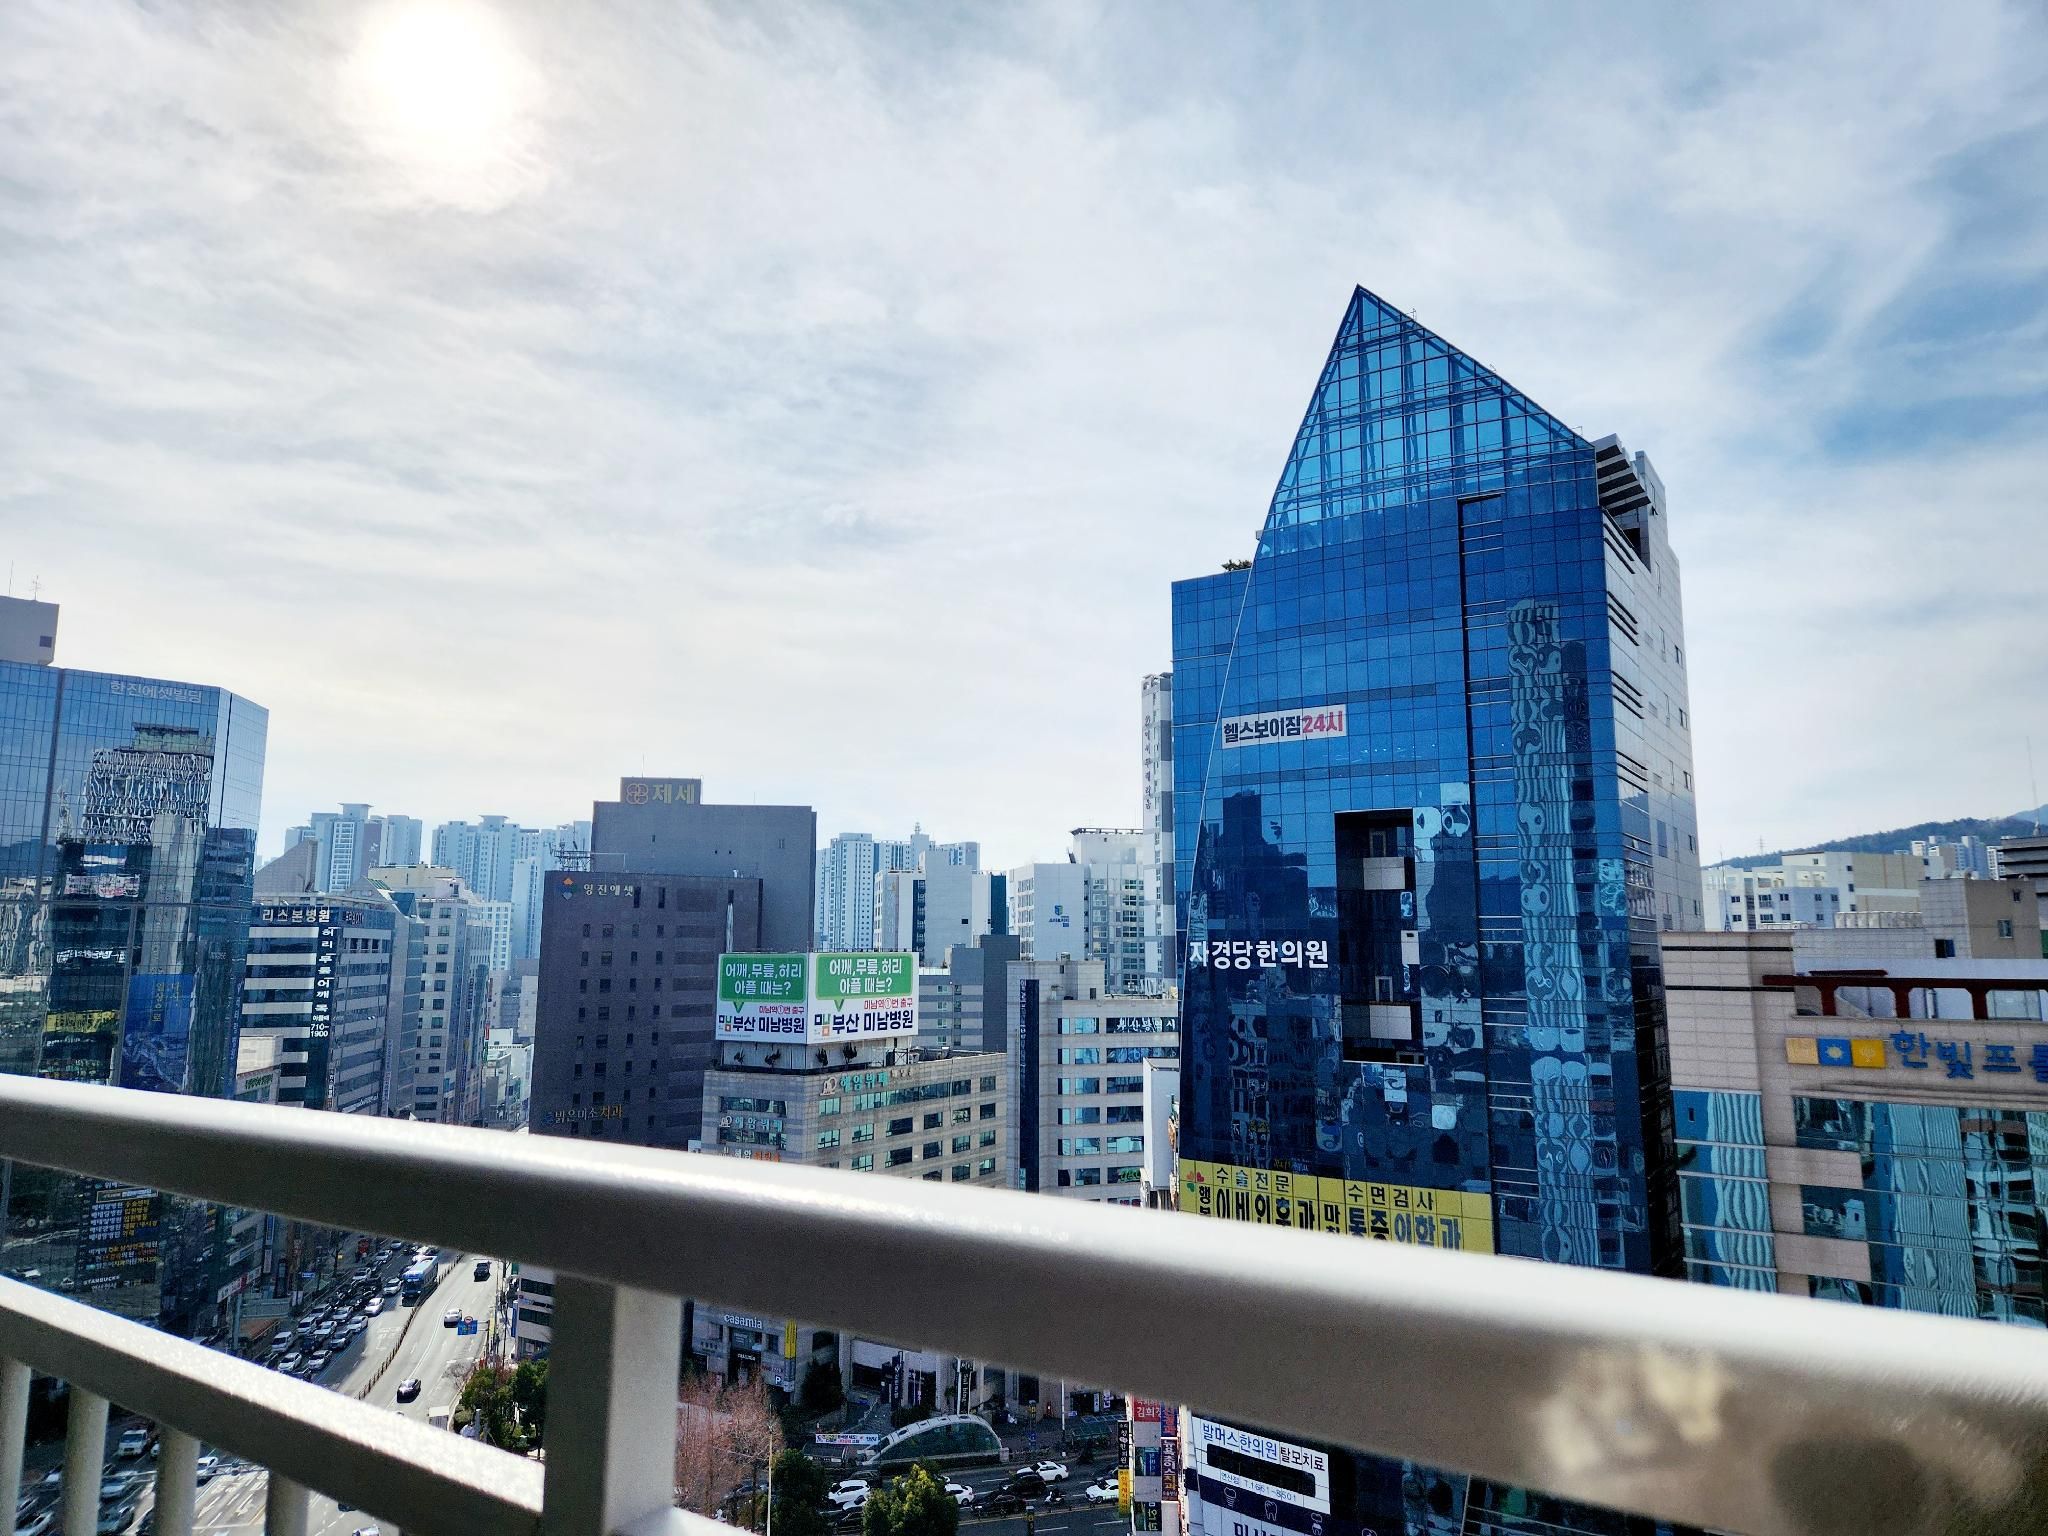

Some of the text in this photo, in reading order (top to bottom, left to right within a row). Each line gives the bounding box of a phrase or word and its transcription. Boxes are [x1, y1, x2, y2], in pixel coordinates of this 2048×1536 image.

[652, 784, 695, 804] 제세
[262, 907, 331, 923] 리스본병원
[1189, 940, 1329, 970] 자경당한의원
[725, 963, 802, 979] 어깨,무릎,허리
[829, 958, 902, 976] 어깨,무릎,허리
[734, 980, 792, 995] 아플 때는?
[839, 976, 893, 994] 아플 때는?
[732, 1015, 805, 1034] 부산 미남병원
[832, 1009, 913, 1034] 부산 미남병원
[310, 1030, 329, 1038] 1900
[555, 1103, 623, 1123] 밝은미소치과
[1216, 1167, 1289, 1193] 수술전문
[1348, 1184, 1433, 1211] 수면검사
[723, 1313, 763, 1330] casamia
[1202, 1422, 1325, 1472] 발머스한의원 탈모치료
